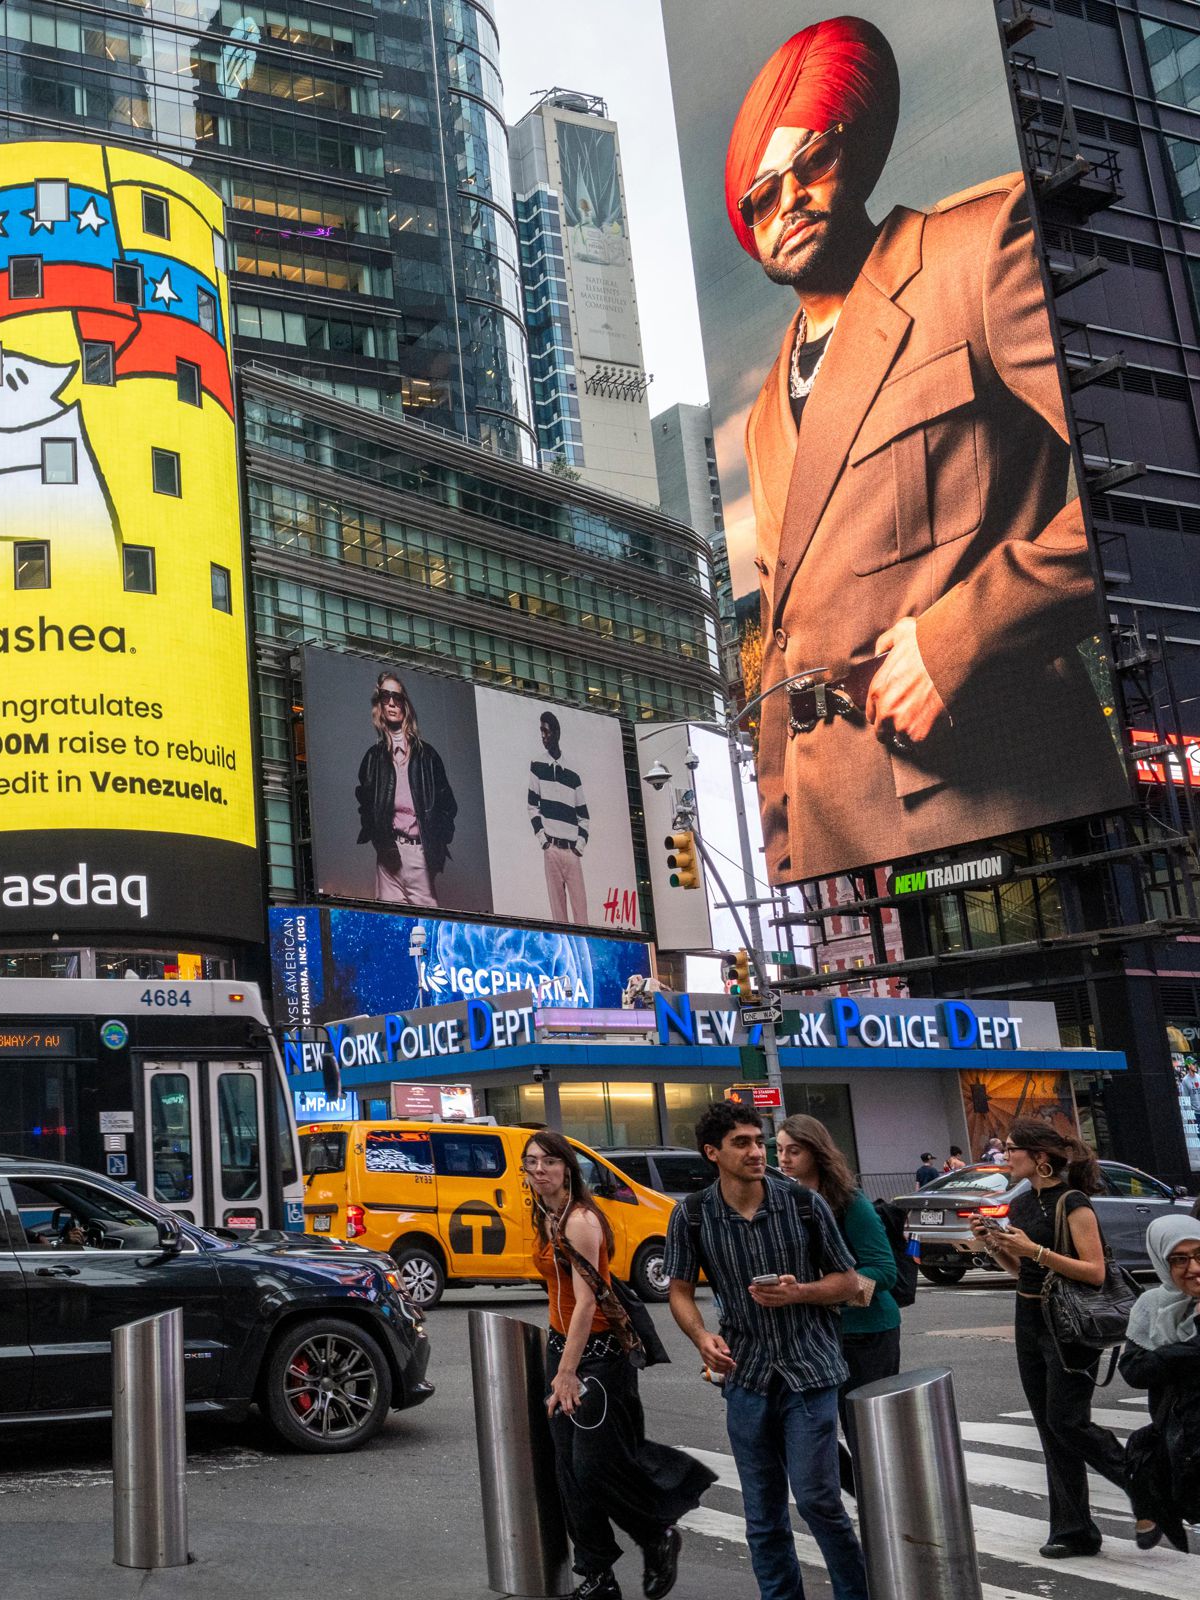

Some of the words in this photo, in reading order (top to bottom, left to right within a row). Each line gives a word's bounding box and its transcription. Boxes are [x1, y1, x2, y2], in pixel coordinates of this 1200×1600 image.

[59, 731, 127, 754] raise
[134, 734, 160, 758] to
[166, 740, 237, 772] rebuild
[57, 770, 82, 793] in
[90, 770, 229, 806] Venezuela.
[296, 915, 307, 940] (IGC)
[603, 887, 636, 928] H&M
[284, 918, 298, 993] AMERICAN
[298, 943, 308, 964] INC.
[140, 989, 192, 1007] 4684
[300, 967, 311, 1016] PHARMA,
[45, 1035, 60, 1047] AV
[385, 1014, 461, 1062] POLICE
[467, 1000, 535, 1051] DEPT
[654, 992, 737, 1047] NEW
[832, 997, 940, 1048] POLICE
[943, 1001, 1023, 1050] DEPT
